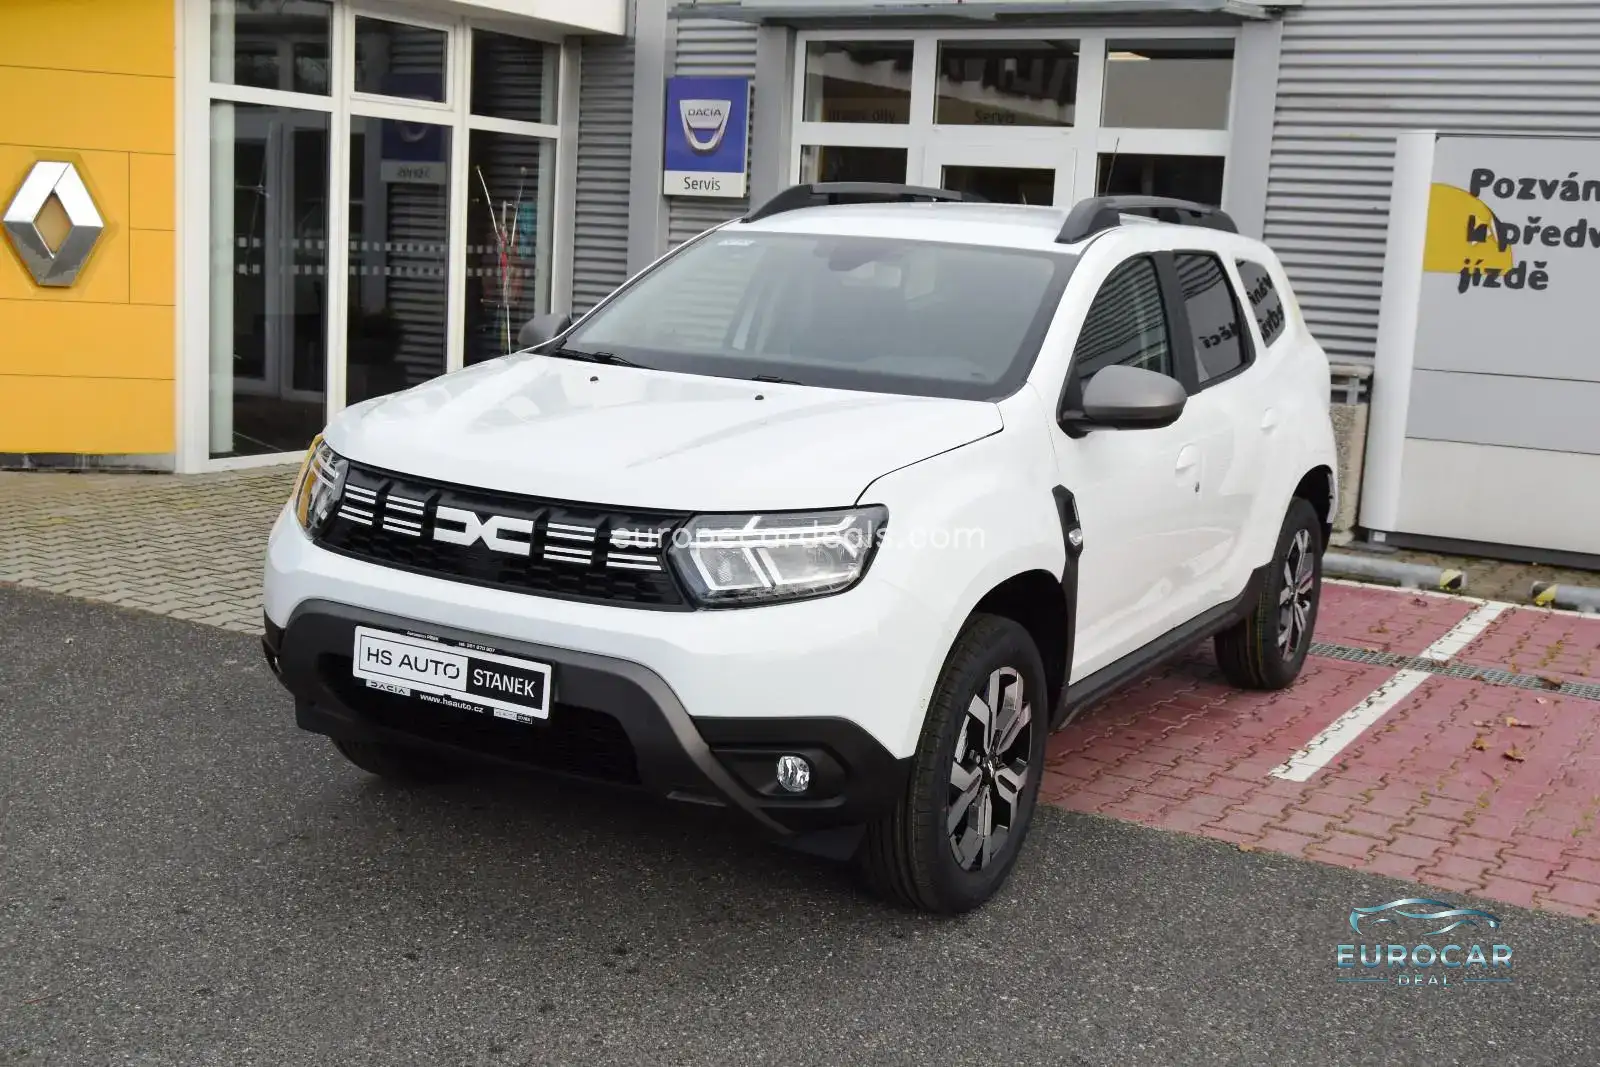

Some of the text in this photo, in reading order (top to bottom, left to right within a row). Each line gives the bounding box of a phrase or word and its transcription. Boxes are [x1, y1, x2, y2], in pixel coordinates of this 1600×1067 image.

[688, 108, 721, 117] DACIA
[684, 176, 721, 191] Servis
[1469, 168, 1600, 202] Pozván
[1458, 258, 1549, 294] jízdě
[367, 646, 393, 666] HS
[398, 654, 460, 680] AUTO
[370, 681, 405, 694] DACIA
[419, 694, 484, 714] www.hsauto.cz
